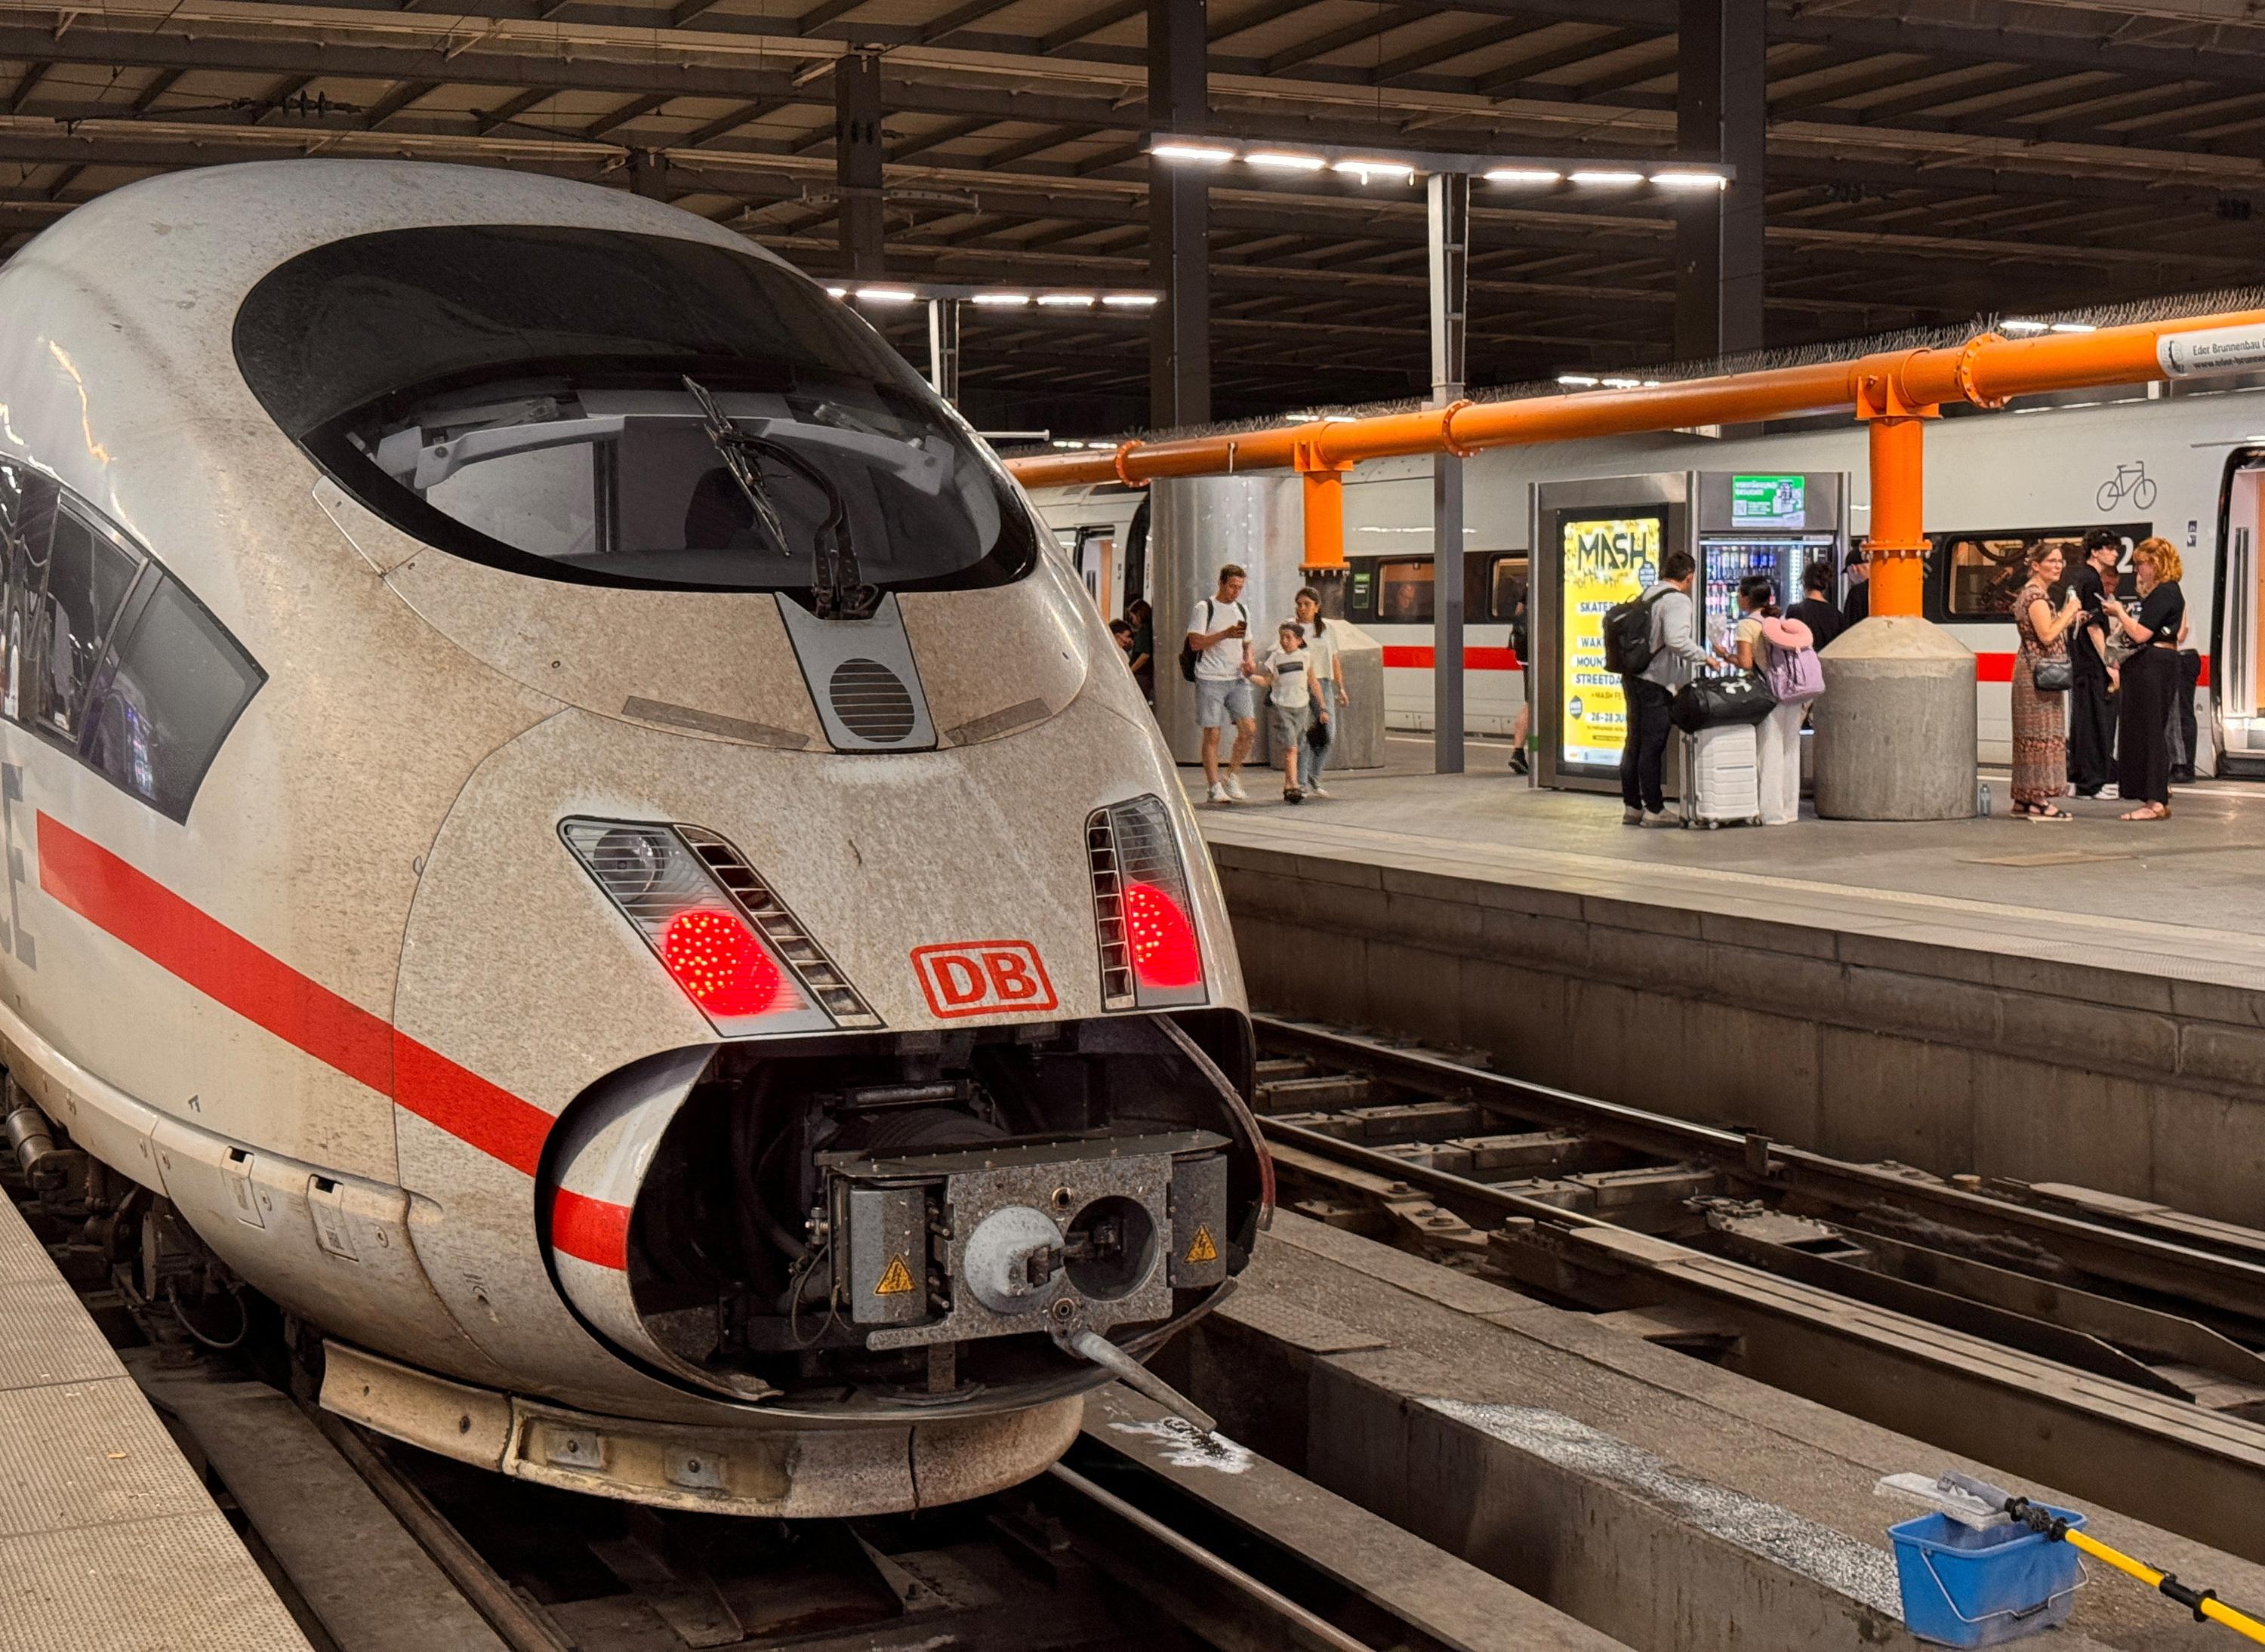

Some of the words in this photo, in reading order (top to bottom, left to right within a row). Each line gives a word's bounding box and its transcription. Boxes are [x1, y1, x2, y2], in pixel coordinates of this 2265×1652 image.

[2193, 345, 2210, 356] Eder
[2212, 342, 2260, 353] Brunnenbau
[1577, 532, 1647, 571] MASH
[2116, 537, 2134, 574] 2
[1581, 637, 1605, 648] WAK
[929, 952, 1037, 1005] DB
